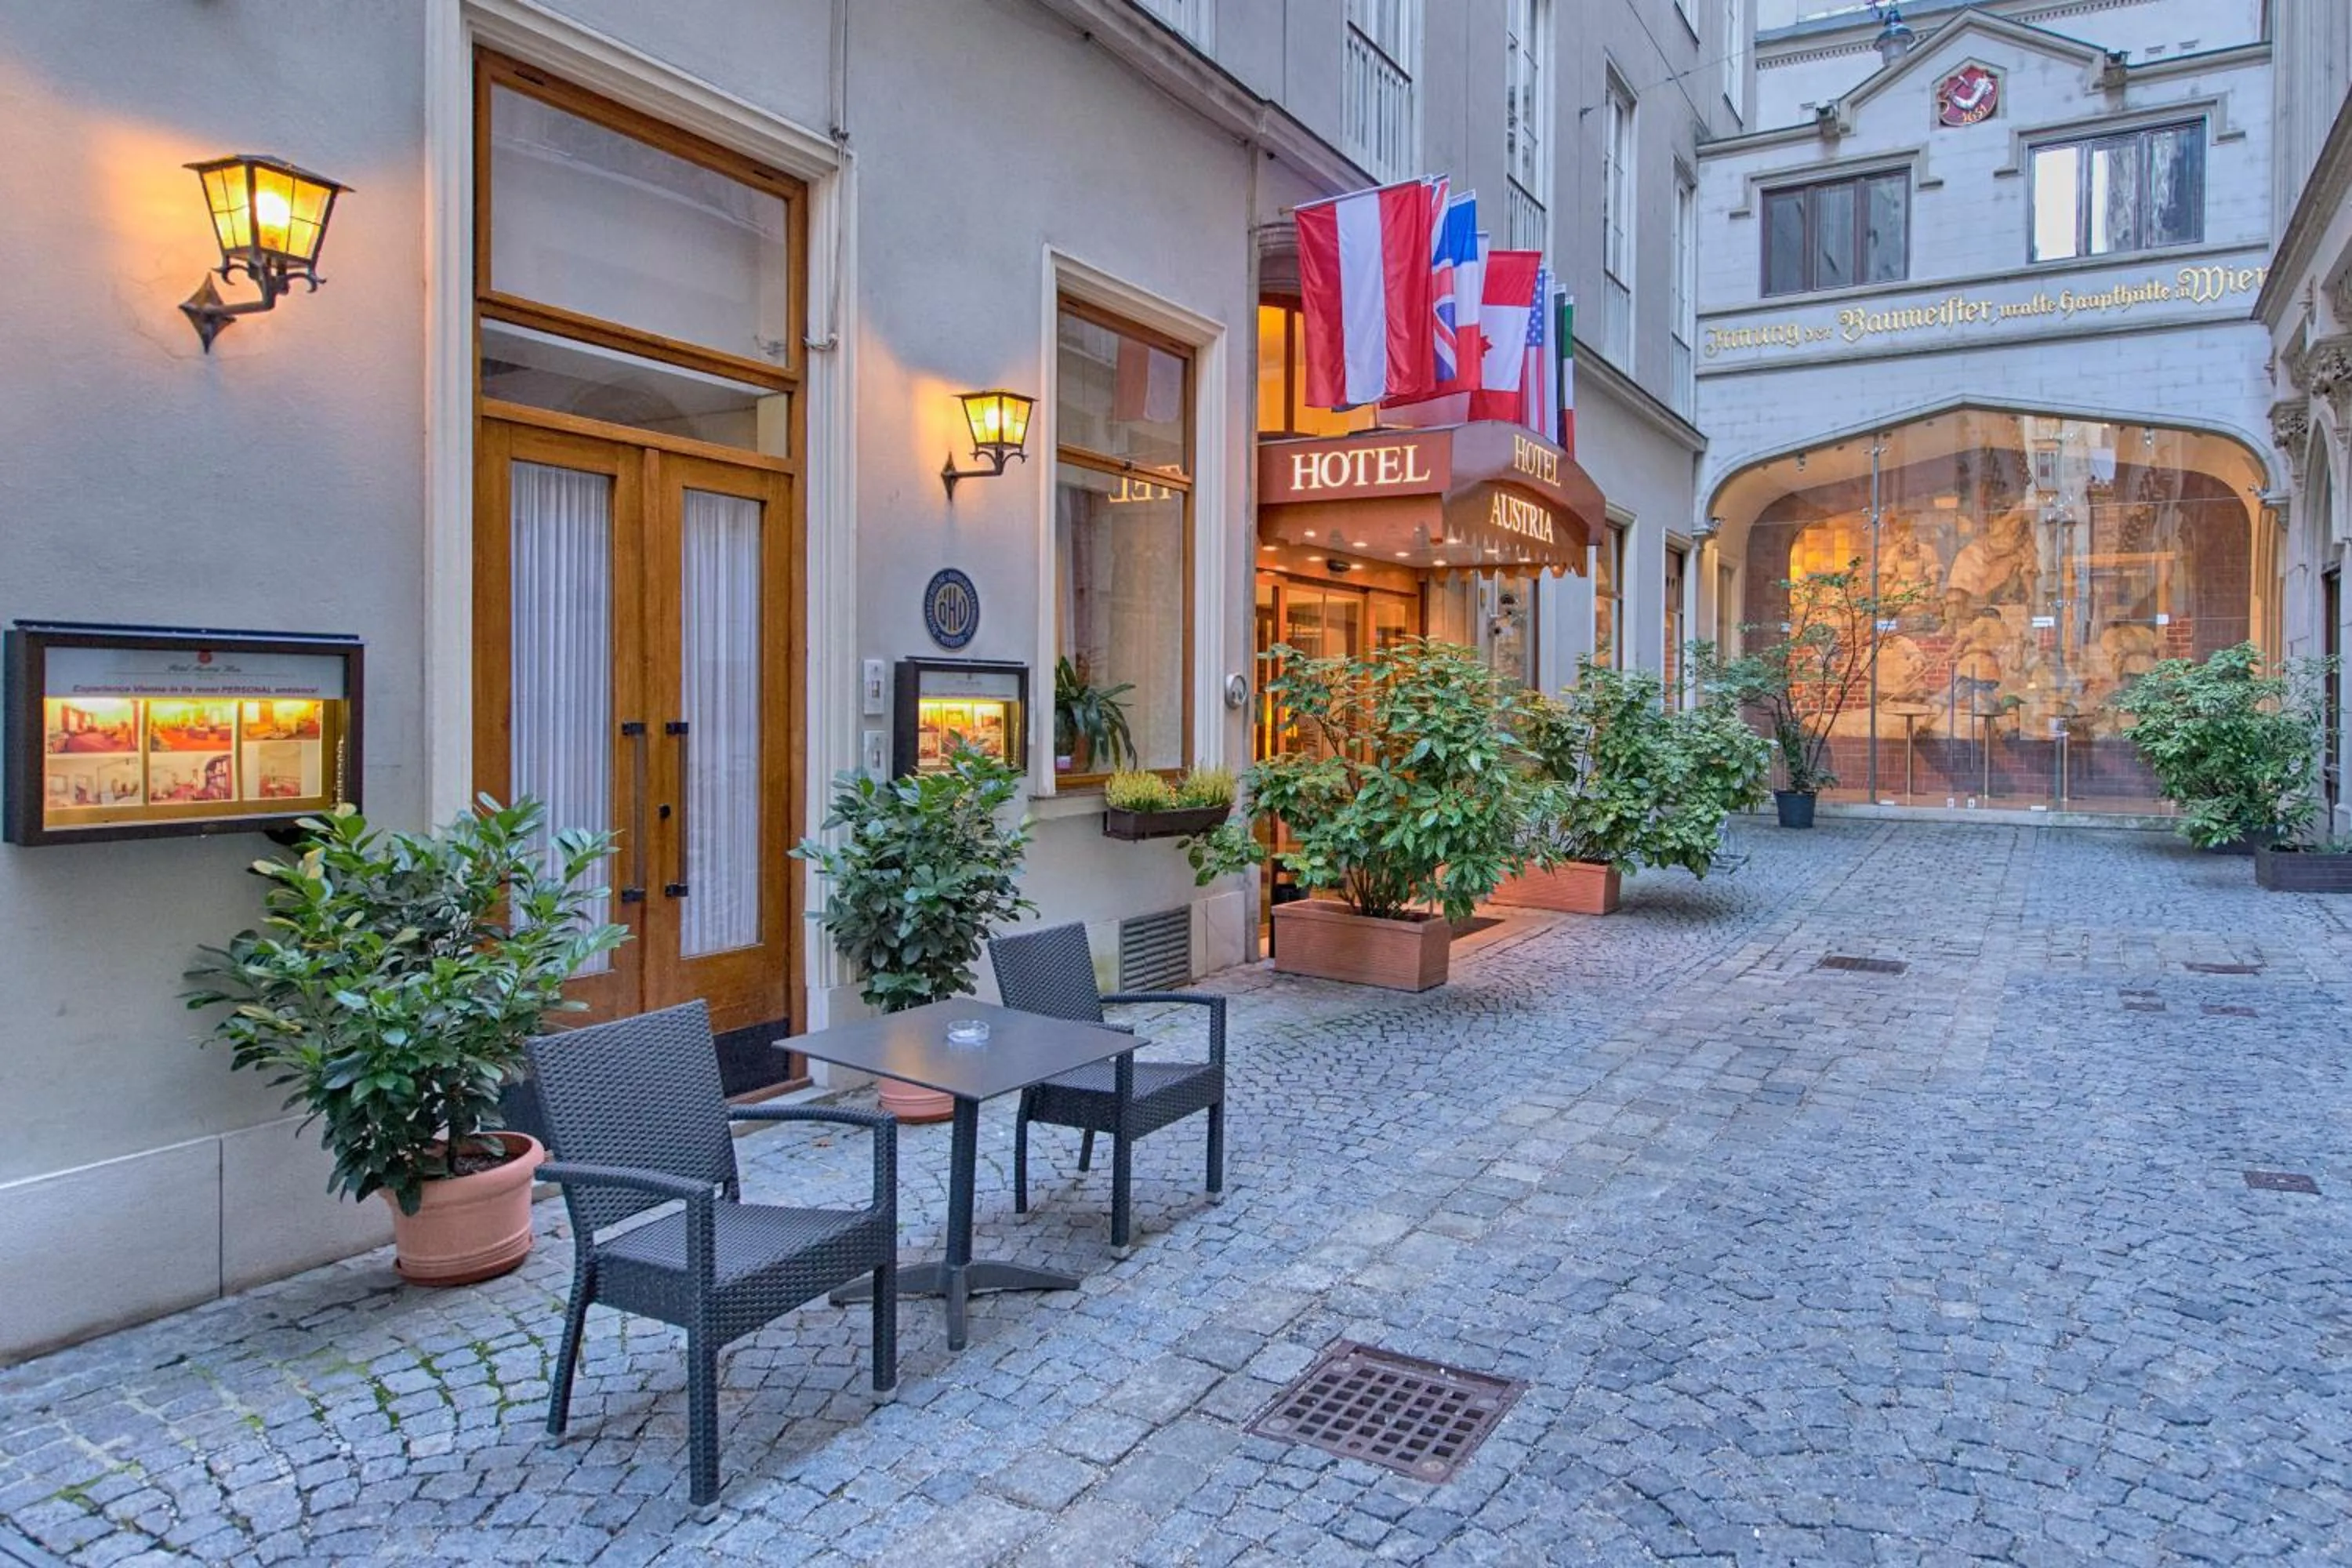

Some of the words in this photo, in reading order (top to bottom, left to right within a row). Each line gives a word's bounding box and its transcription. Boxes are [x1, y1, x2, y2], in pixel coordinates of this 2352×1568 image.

[1290, 445, 1432, 492] HOTEL
[1513, 434, 1562, 488] HOTEL
[1490, 492, 1555, 544] AUSTRIA
